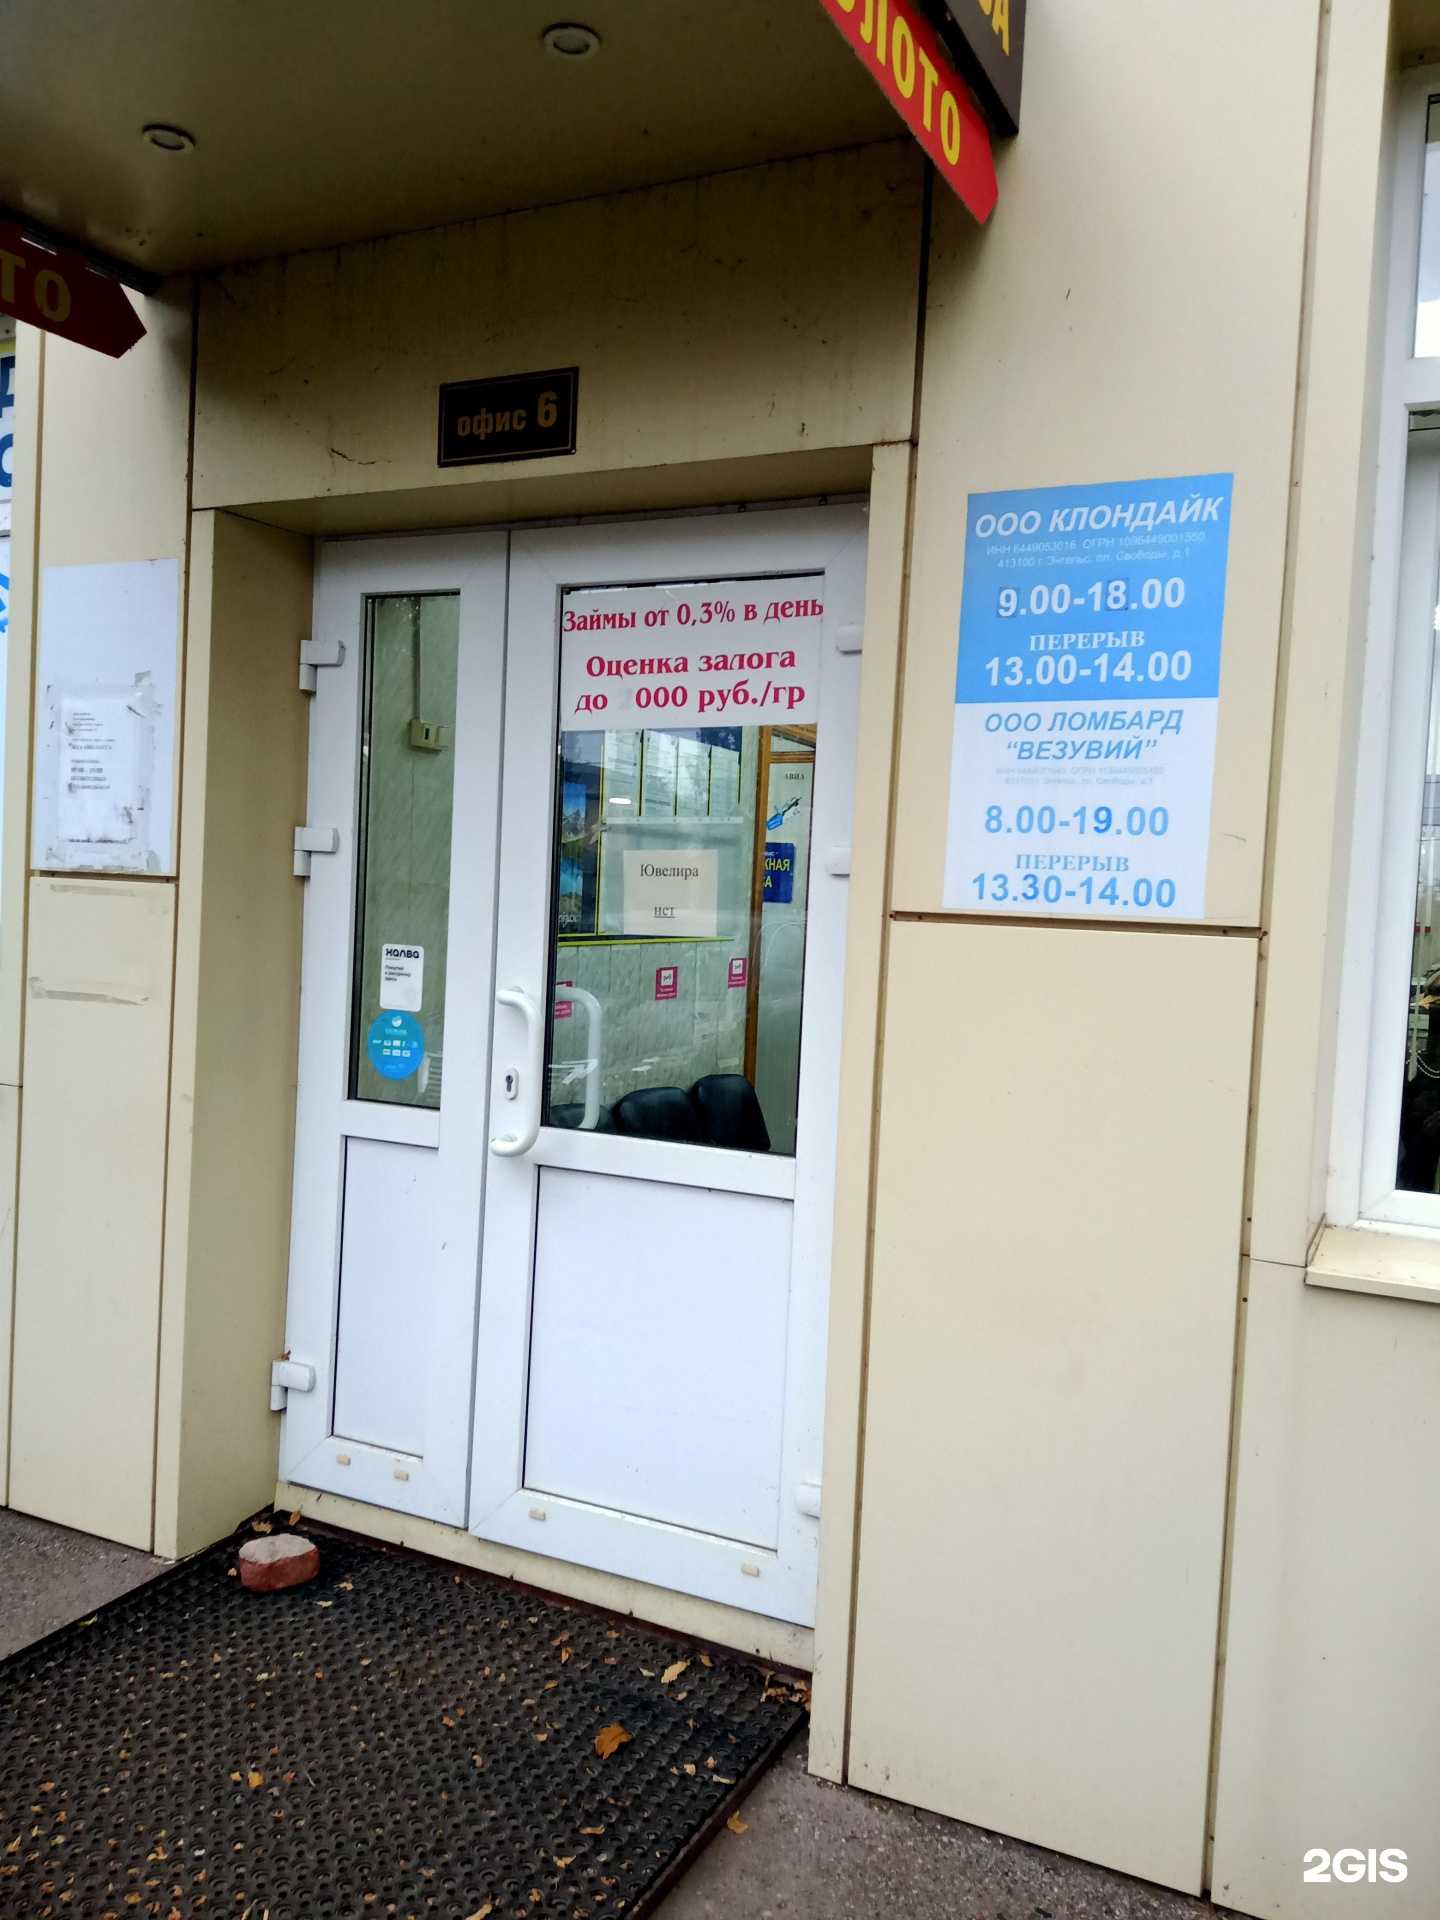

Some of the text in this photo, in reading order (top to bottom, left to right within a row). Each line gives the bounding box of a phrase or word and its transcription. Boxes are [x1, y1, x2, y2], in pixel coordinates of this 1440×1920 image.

[835, 0, 960, 166] ЛОТО
[457, 390, 559, 440] офис 6
[975, 492, 1225, 538] ООО КЛОНДАЙК
[998, 577, 1186, 617] 9.00-18.00
[563, 598, 824, 632] Займы от 0,3% в день
[1029, 630, 1146, 651] ПЕРЕРЫВ
[586, 650, 796, 680] Оценка залога
[985, 650, 1193, 686] 13.00-14.00
[574, 679, 806, 715] до 000 руб./гр
[984, 709, 1184, 735] ООО ЛОМБАРД
[984, 804, 1170, 836] 8.00-19.00
[640, 863, 699, 881] Ювелира
[1015, 853, 1130, 872] ПЕРЕРЫВ
[972, 872, 1177, 908] 13.30-14.00
[653, 906, 677, 918] нет
